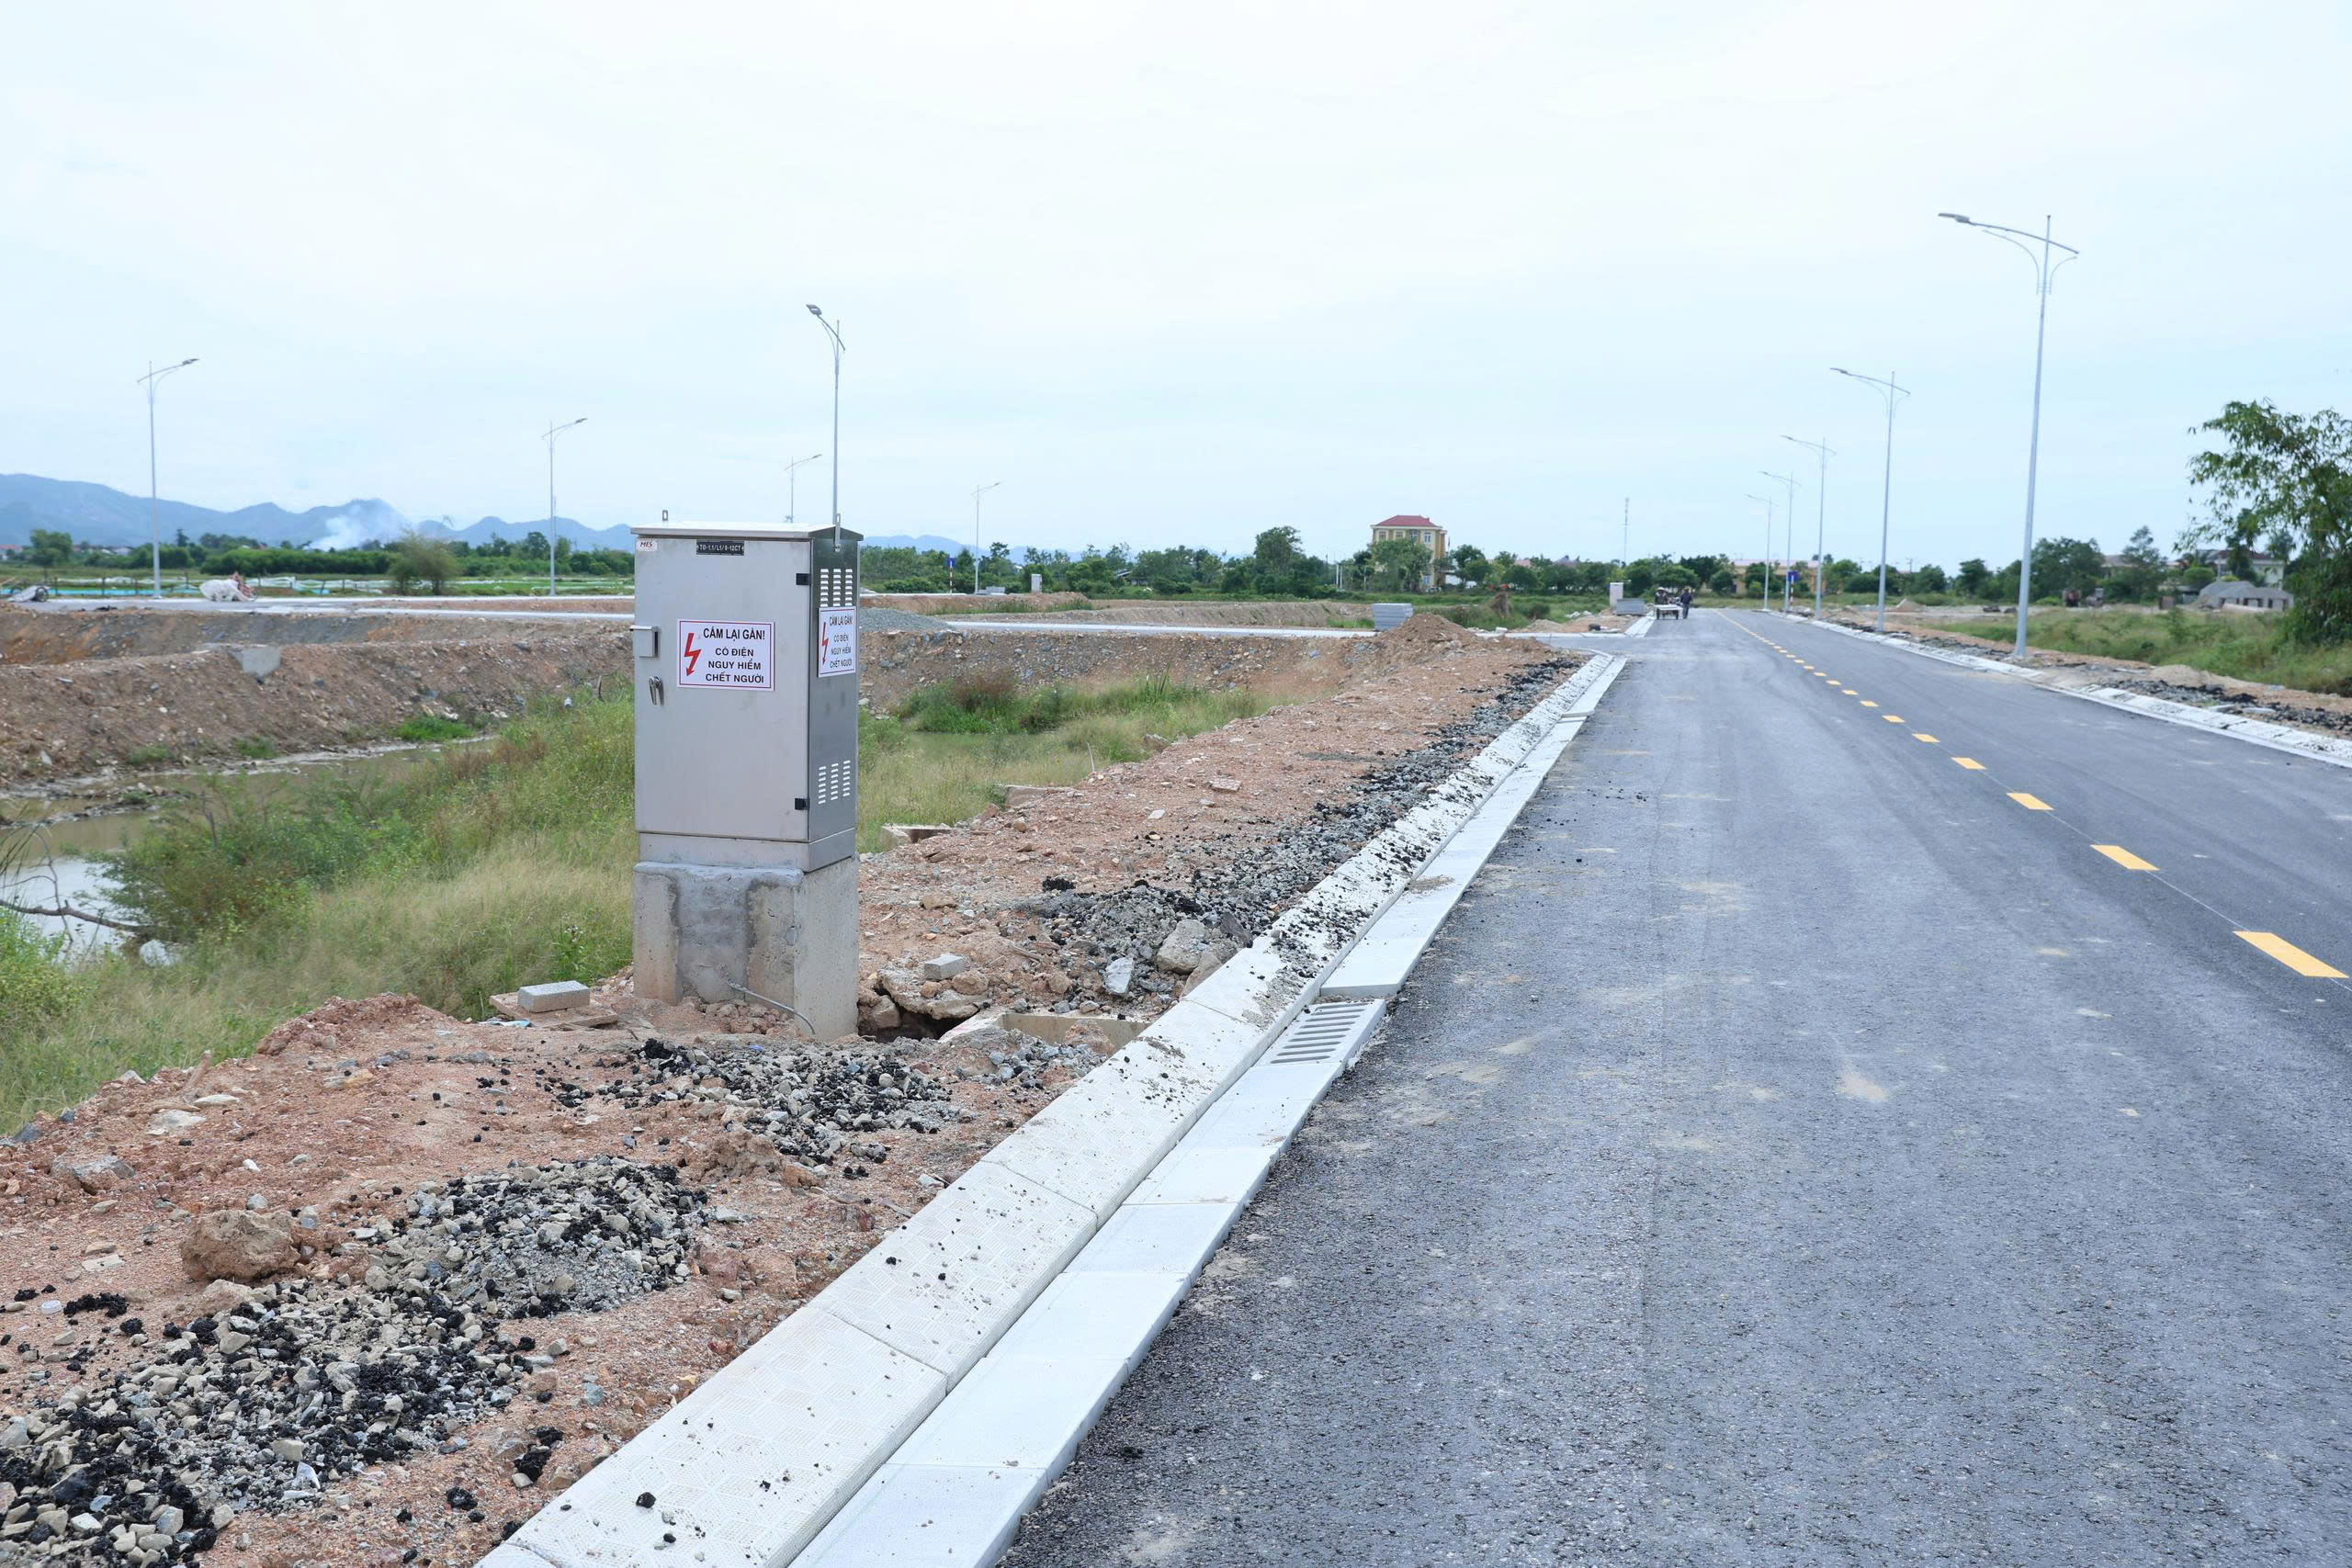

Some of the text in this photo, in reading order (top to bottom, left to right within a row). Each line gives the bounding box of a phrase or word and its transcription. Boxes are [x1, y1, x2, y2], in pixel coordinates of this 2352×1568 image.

[726, 628, 741, 642] LẠI
[715, 647, 754, 659] CÓ ĐIỆN
[707, 658, 762, 671] NGUY HIỂM
[705, 671, 764, 683] CHẾT NGƯỜI
